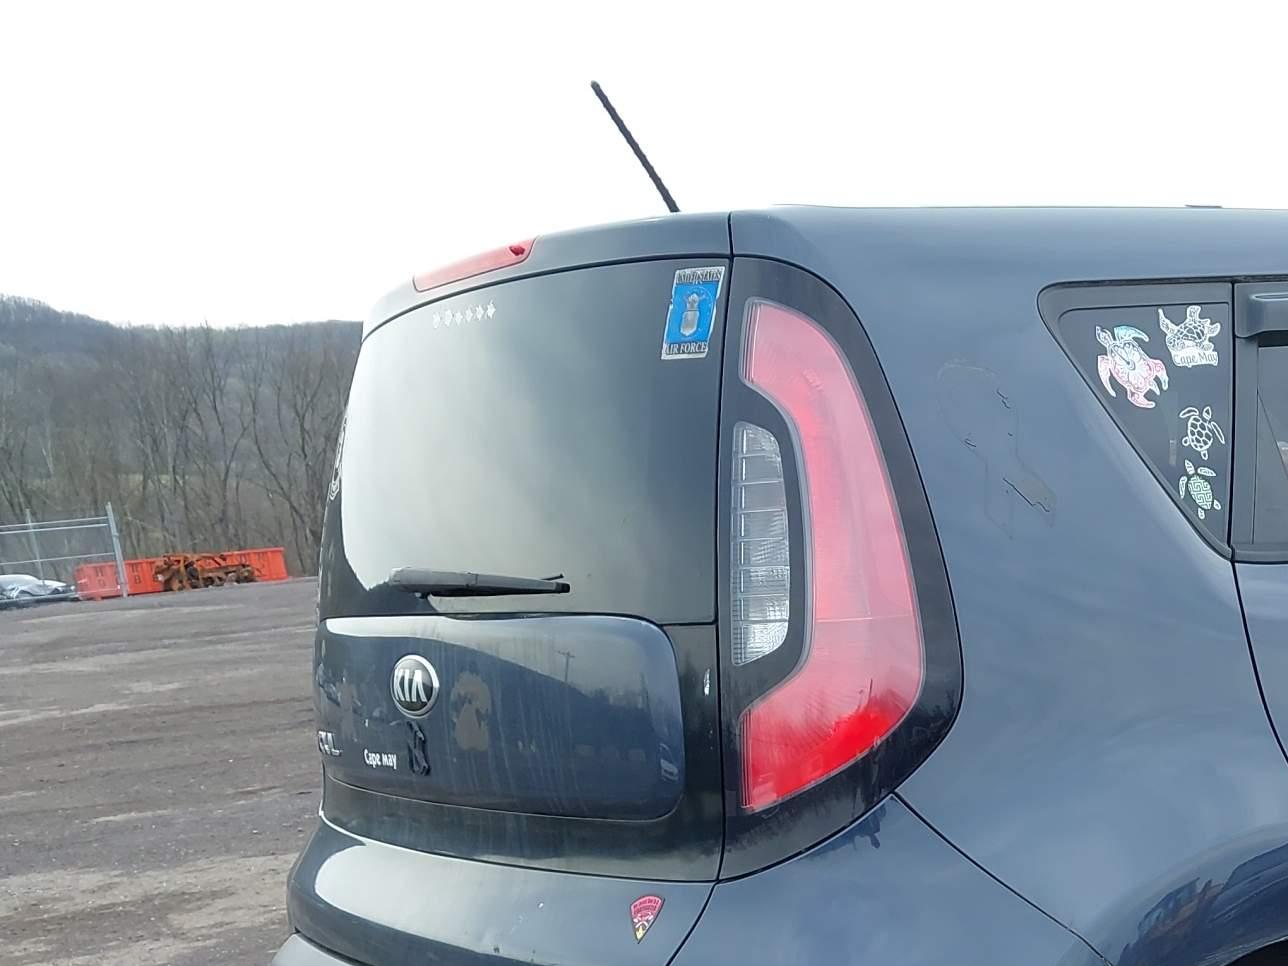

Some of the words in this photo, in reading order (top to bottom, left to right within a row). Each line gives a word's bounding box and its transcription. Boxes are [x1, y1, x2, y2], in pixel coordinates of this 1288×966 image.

[664, 344, 679, 354] AIR
[680, 342, 707, 353] FORCE
[1173, 354, 1198, 366] Cape
[1197, 352, 1218, 364] May
[393, 668, 427, 703] KIA
[363, 748, 381, 768] Cape
